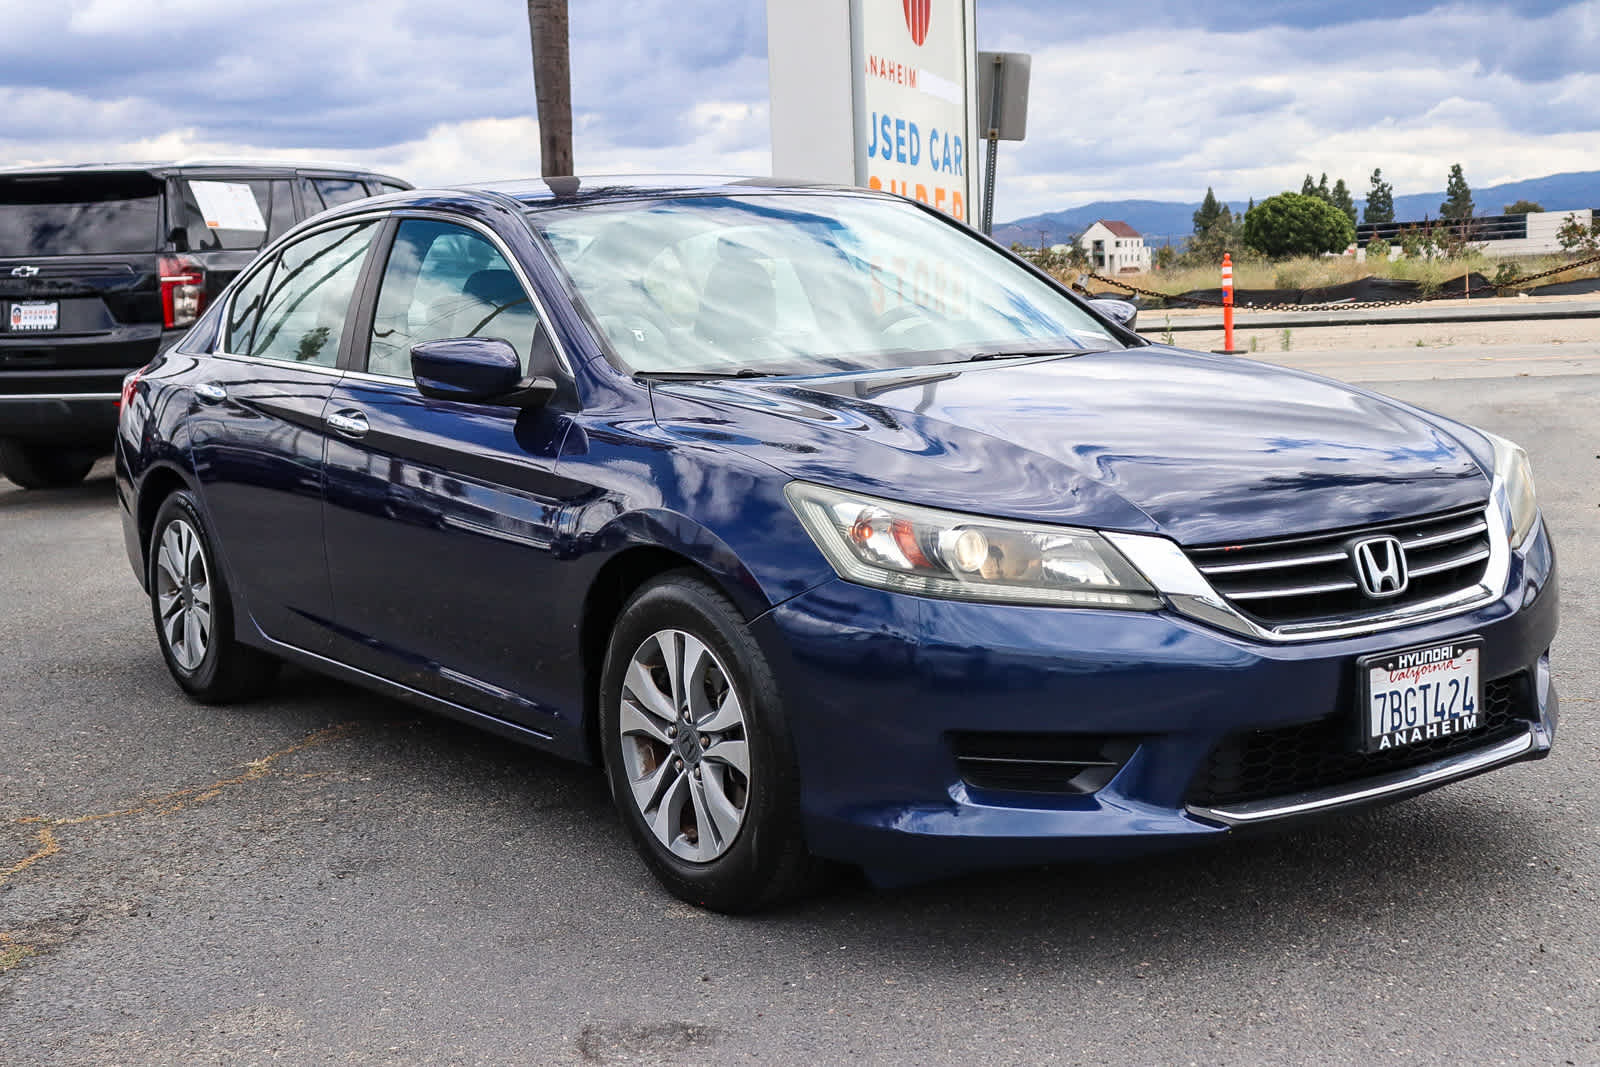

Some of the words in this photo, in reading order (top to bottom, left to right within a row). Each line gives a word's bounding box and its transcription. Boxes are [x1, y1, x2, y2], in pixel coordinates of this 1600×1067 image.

[929, 128, 963, 176] CAR
[1398, 645, 1454, 669] HYUNDAI
[1374, 675, 1475, 734] 7BGT424
[1379, 714, 1477, 750] ANAHEIM
